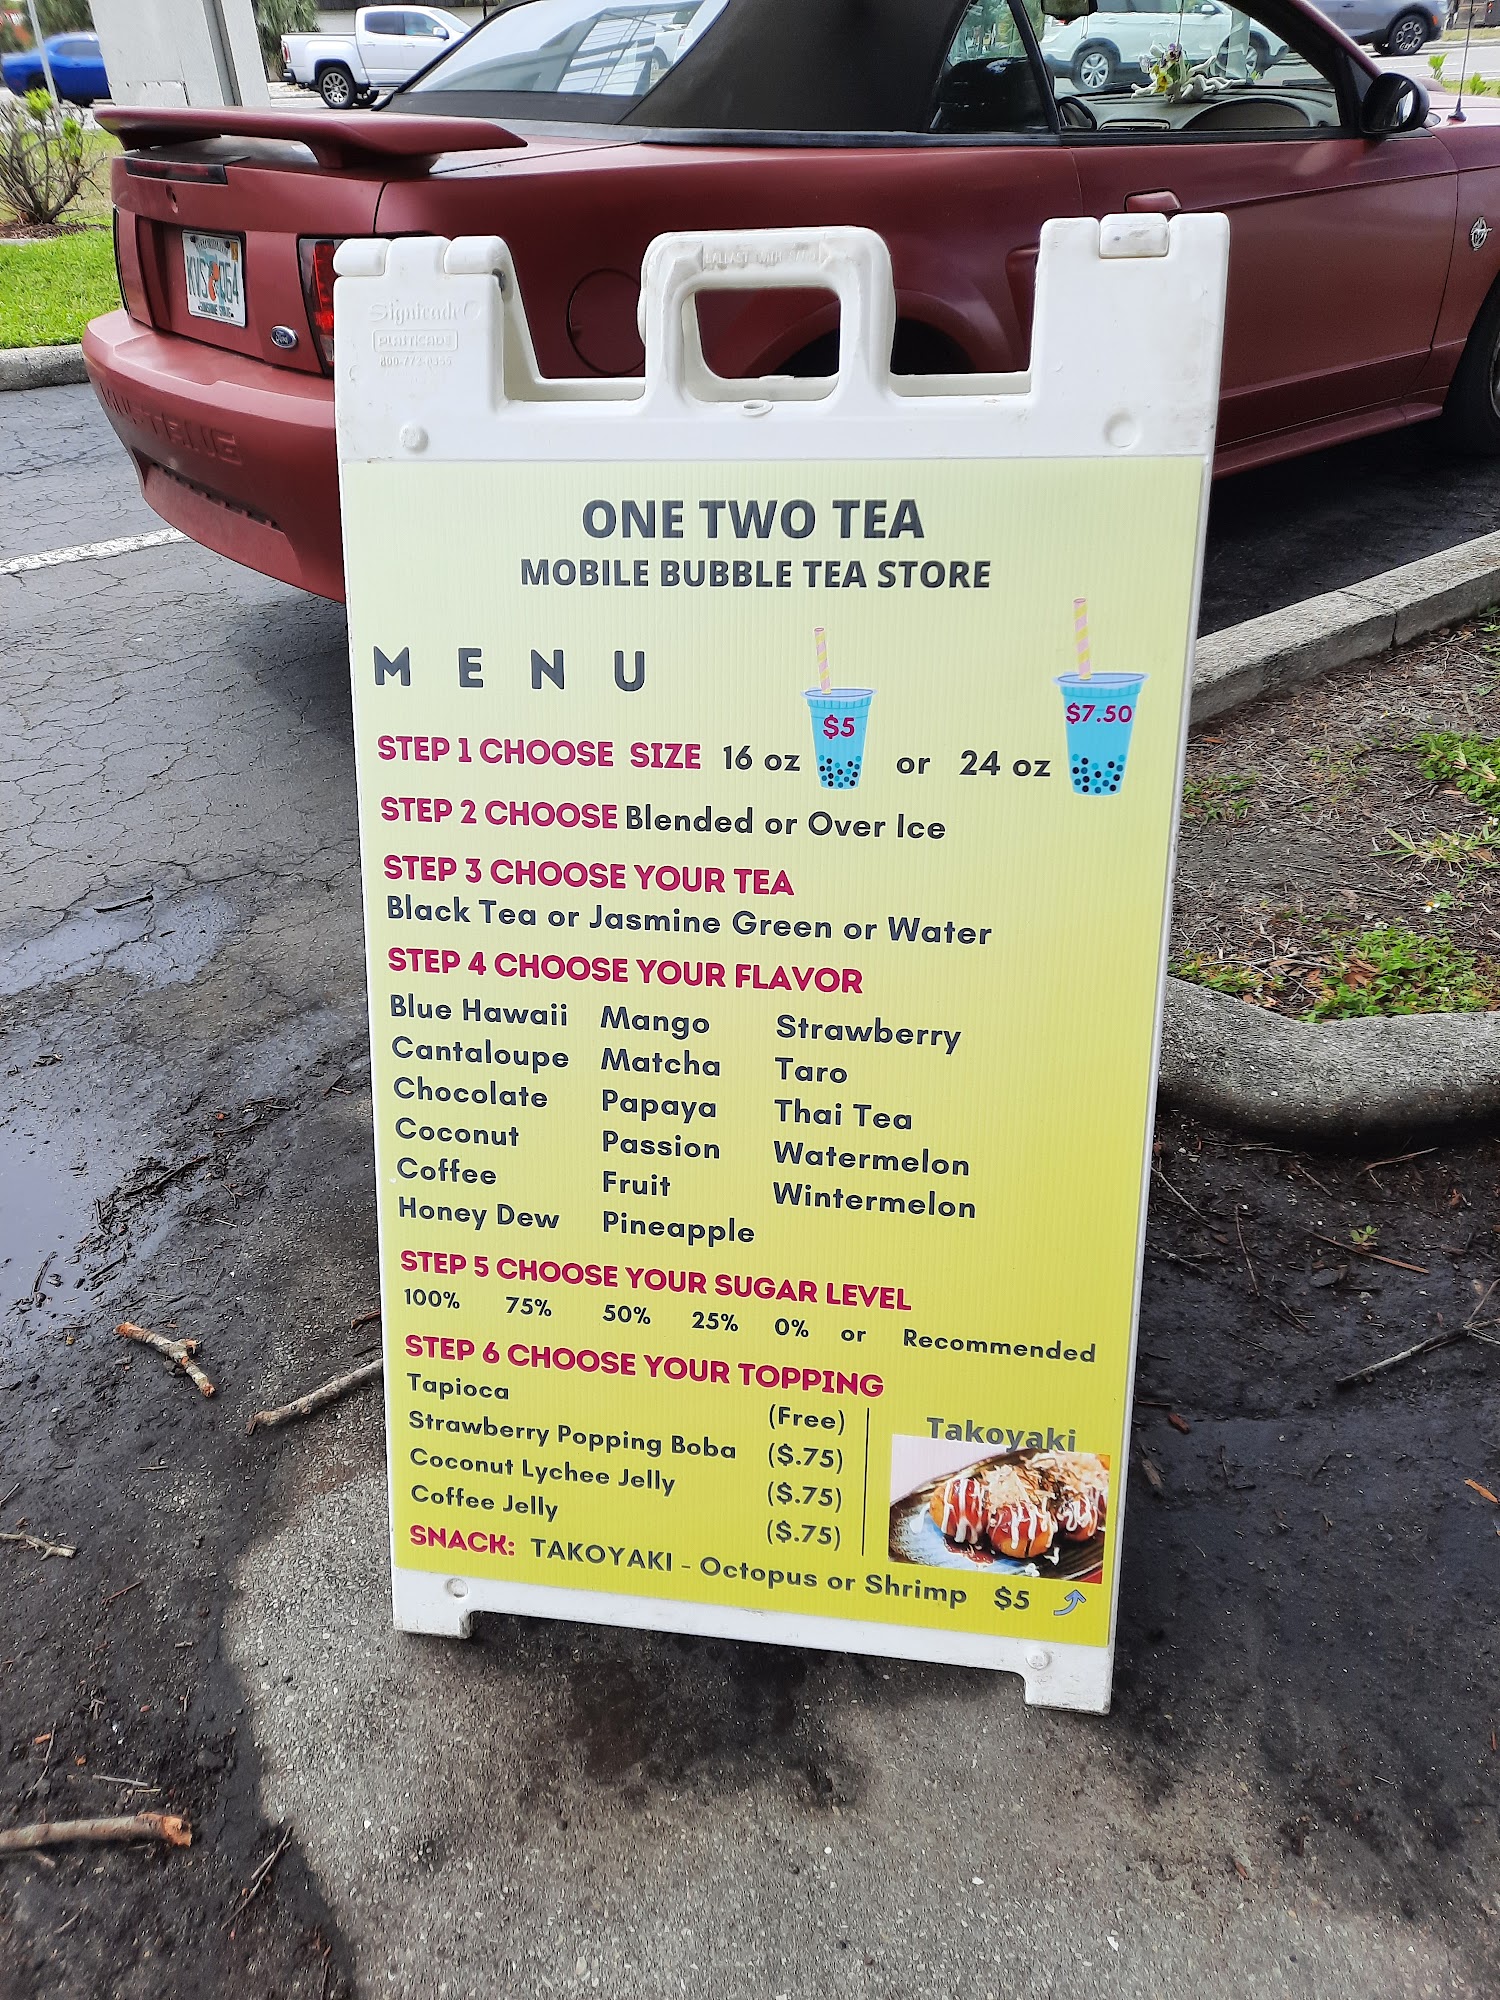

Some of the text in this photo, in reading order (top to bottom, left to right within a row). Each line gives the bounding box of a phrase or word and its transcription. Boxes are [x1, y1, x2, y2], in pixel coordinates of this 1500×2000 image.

[582, 498, 925, 540] ONE TWO TEA
[520, 558, 991, 589] MOBILE BUBBLE TEA STORE
[822, 713, 856, 740] $5
[1065, 702, 1133, 725] $7.50
[377, 734, 1051, 778] STEP 1 CHOOSE SIZE 16 oz or 24 oz
[380, 796, 946, 840] STEP 2 CHOOSE Blended or Over Ice
[383, 854, 795, 896] STEP 3 CHOOSE YOUR TEA
[387, 893, 993, 945] Black Tea or Jasmine Green or Water
[387, 946, 863, 994] STEP 4 CHOOSE YOUR FLAVOR
[390, 992, 567, 1027] Blue Hawaii
[600, 1005, 710, 1041] Mango
[776, 1014, 962, 1057] Strawberry
[391, 1035, 569, 1075] Cantaloupe
[600, 1047, 720, 1077] Matcha
[774, 1056, 848, 1084] Taro
[393, 1075, 548, 1108] Chocolate
[602, 1088, 717, 1124] Papaya
[773, 1097, 912, 1130] Thai Tea
[395, 1117, 520, 1147] Coconut
[602, 1129, 720, 1160] Passion
[396, 1156, 497, 1185] Coffee
[773, 1140, 969, 1177] Watermelon
[603, 1170, 671, 1197] Fruit
[772, 1181, 976, 1219] Wintermelon
[398, 1196, 560, 1231] Honey Dew
[603, 1210, 755, 1248] Pineapple
[400, 1249, 912, 1311] STEP 5 CHOOSE YOUR SUGAR LEVEL
[403, 1288, 1096, 1363] 100% 75% 50% 25% 0% or Recommended
[405, 1334, 884, 1398] STEP 6 CHOOSE YOUR TOPPING
[406, 1372, 509, 1401] Tapioca
[408, 1410, 736, 1460] Strawberry Popping Boba
[769, 1403, 845, 1436] (Free)
[926, 1416, 1076, 1453] Takoyaki
[409, 1447, 676, 1498] Coconut Lychee Jelly
[768, 1442, 843, 1475] ($.75)
[411, 1484, 559, 1523] Coffee Jelly
[767, 1481, 842, 1514] ($.75)
[766, 1519, 841, 1552] ($.75)
[409, 1524, 515, 1557] SNACK:
[530, 1537, 672, 1572] TAKOYAKI
[699, 1556, 818, 1590] Octopus
[827, 1576, 856, 1591] or
[864, 1573, 967, 1610] Shrimp
[993, 1585, 1030, 1611] $5
